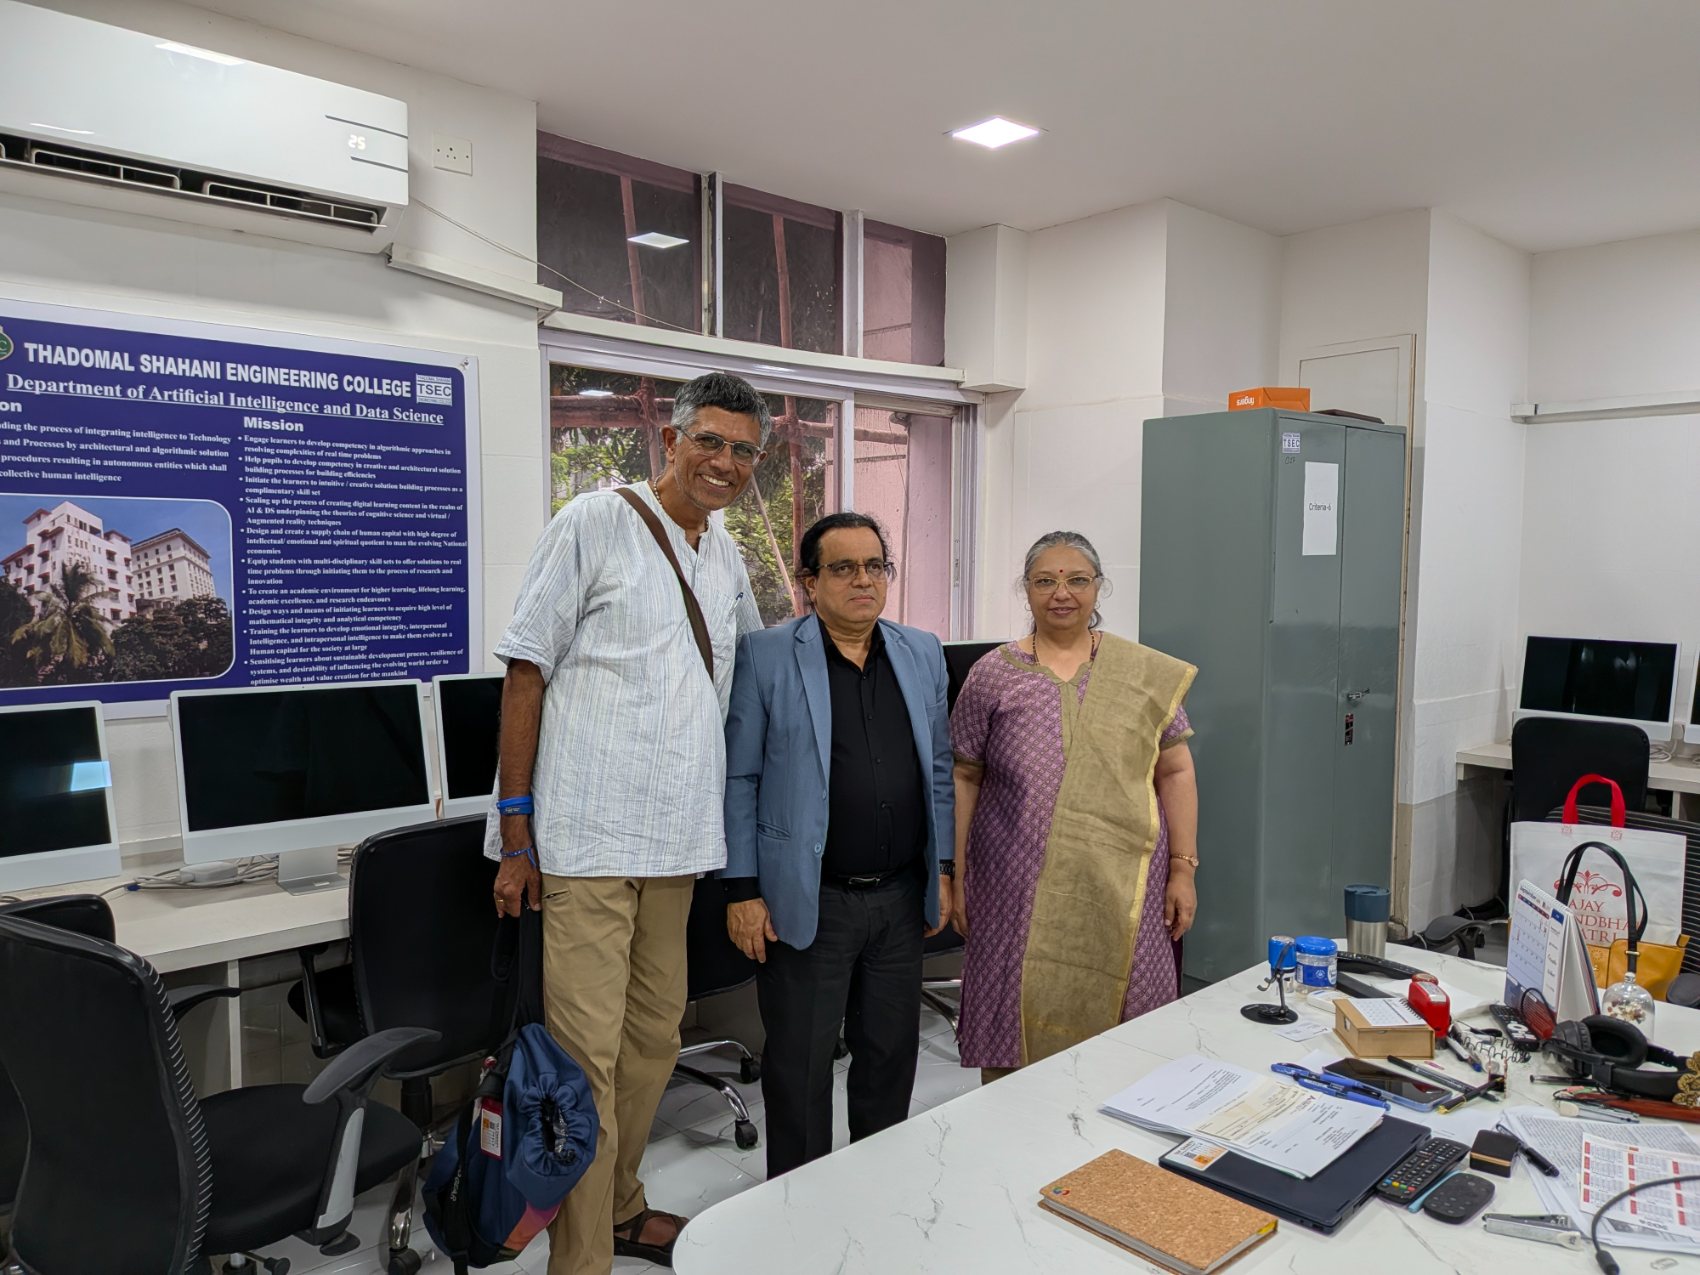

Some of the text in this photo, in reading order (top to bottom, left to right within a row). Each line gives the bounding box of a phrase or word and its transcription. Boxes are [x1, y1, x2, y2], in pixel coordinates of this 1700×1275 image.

[348, 134, 366, 150] 25
[24, 342, 135, 371] THADOMAL
[140, 354, 220, 379] SHAHANI
[227, 363, 338, 390] ENGINEERING
[344, 375, 411, 397] COLLEGE
[418, 384, 452, 397] TSEC
[7, 374, 444, 423] Department of Artificial Intelligence and Data Science
[0, 402, 22, 412] on
[244, 416, 304, 432] Mission
[24, 423, 38, 431] the
[85, 427, 131, 438] integrating
[133, 430, 178, 440] intelligence
[189, 433, 231, 444] Technology
[23, 438, 64, 448] Processes
[66, 441, 76, 451] by
[80, 442, 133, 452] architectural
[153, 446, 197, 455] algorithmic
[245, 435, 269, 444] Engage
[306, 439, 331, 448] develop
[332, 442, 367, 450] competency
[245, 445, 275, 455] resolving
[2, 454, 51, 463] procedures
[53, 457, 91, 467] resulting
[103, 459, 153, 468] autonomous
[245, 456, 261, 464] Help
[292, 458, 317, 467] develop
[318, 460, 354, 469] competency
[42, 471, 72, 479] human
[75, 472, 122, 482] intelligence
[245, 465, 272, 475] building
[317, 470, 342, 478] building
[246, 497, 270, 505] Scaling
[374, 501, 398, 510] learning
[248, 558, 268, 566] Equip
[276, 647, 298, 655] capital
[1569, 899, 1604, 912] AJAY
